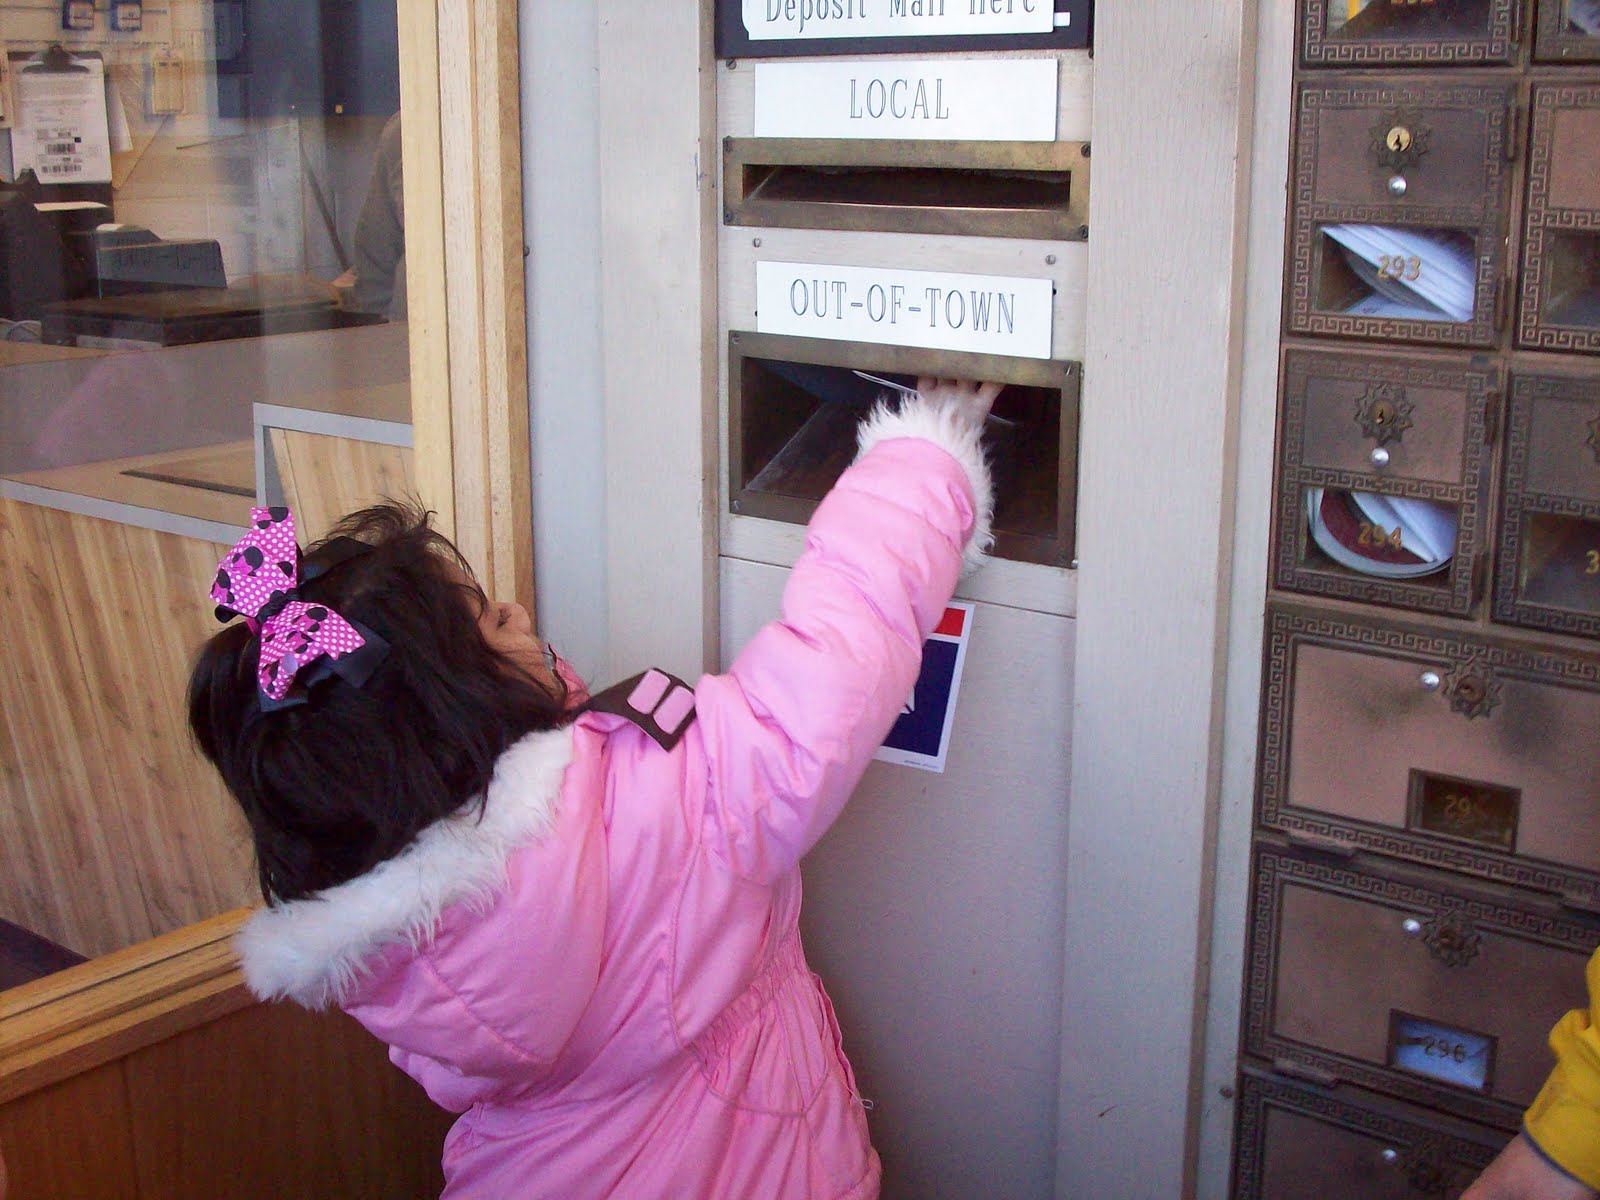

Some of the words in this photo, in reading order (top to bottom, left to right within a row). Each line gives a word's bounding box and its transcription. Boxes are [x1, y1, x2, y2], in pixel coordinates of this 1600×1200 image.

[766, 0, 866, 33] Deposit
[849, 78, 949, 120] LOCAL
[1376, 254, 1421, 282] 293
[790, 278, 1016, 335] OUT-OF-TOWN
[1357, 521, 1403, 552] 294
[1444, 793, 1483, 820] 29
[1424, 1035, 1466, 1064] 296
